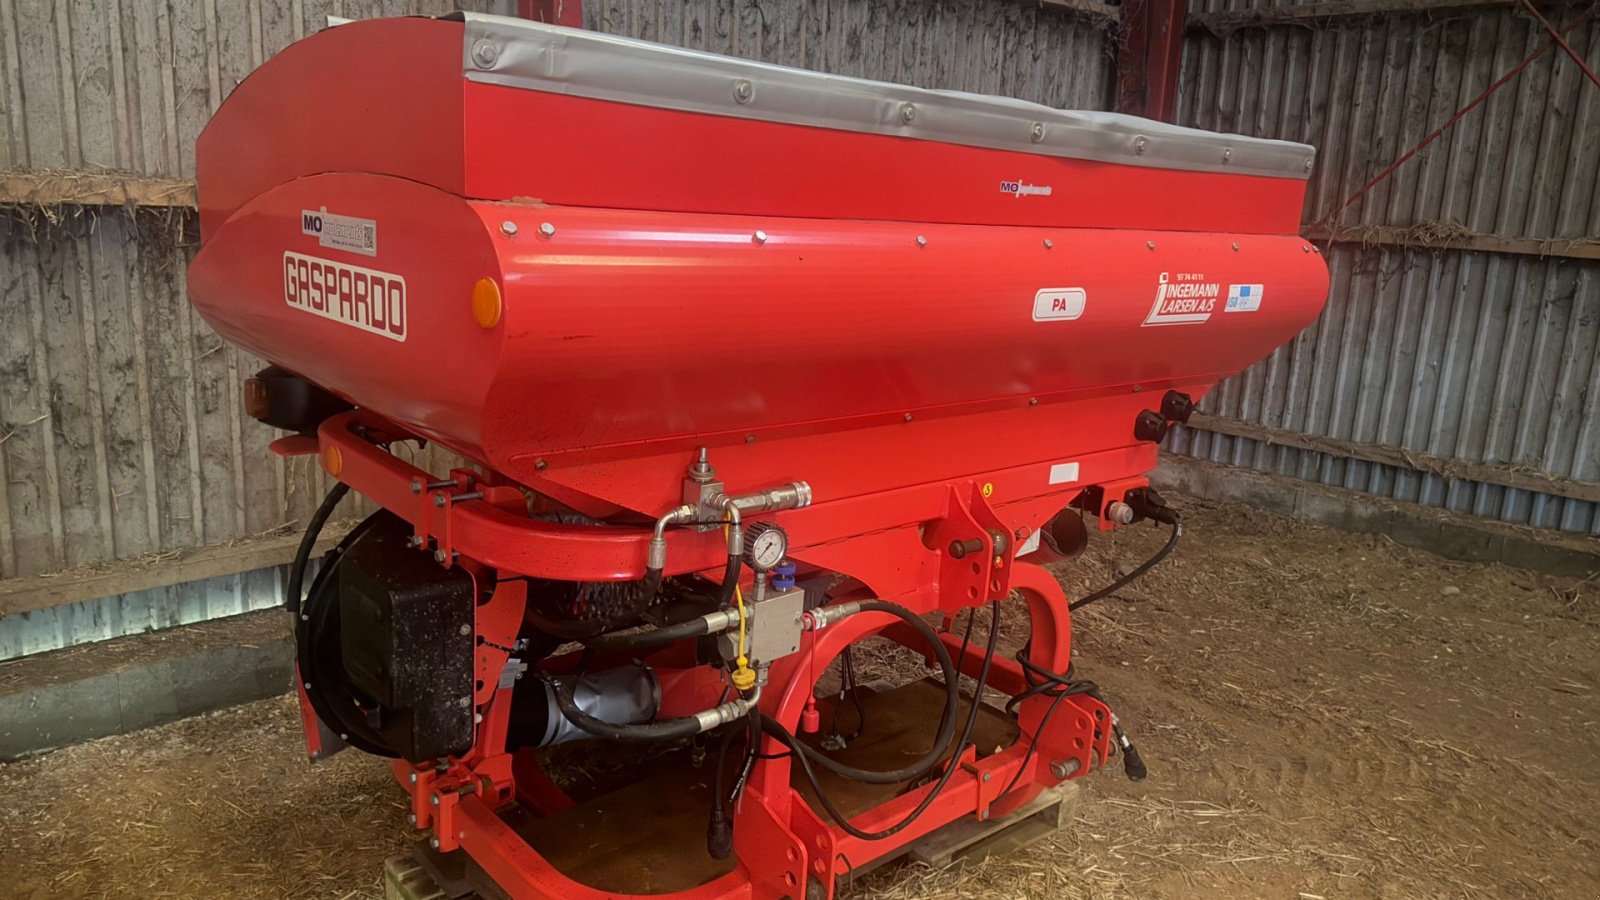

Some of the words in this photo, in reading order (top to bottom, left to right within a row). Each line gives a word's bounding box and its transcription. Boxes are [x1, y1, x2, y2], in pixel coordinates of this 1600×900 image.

[1001, 182, 1019, 192] MO
[303, 214, 322, 233] MO
[285, 256, 404, 336] GASPARDO
[1052, 298, 1067, 311] PA
[1160, 299, 1199, 314] LARSEN
[1196, 298, 1217, 312] A/S
